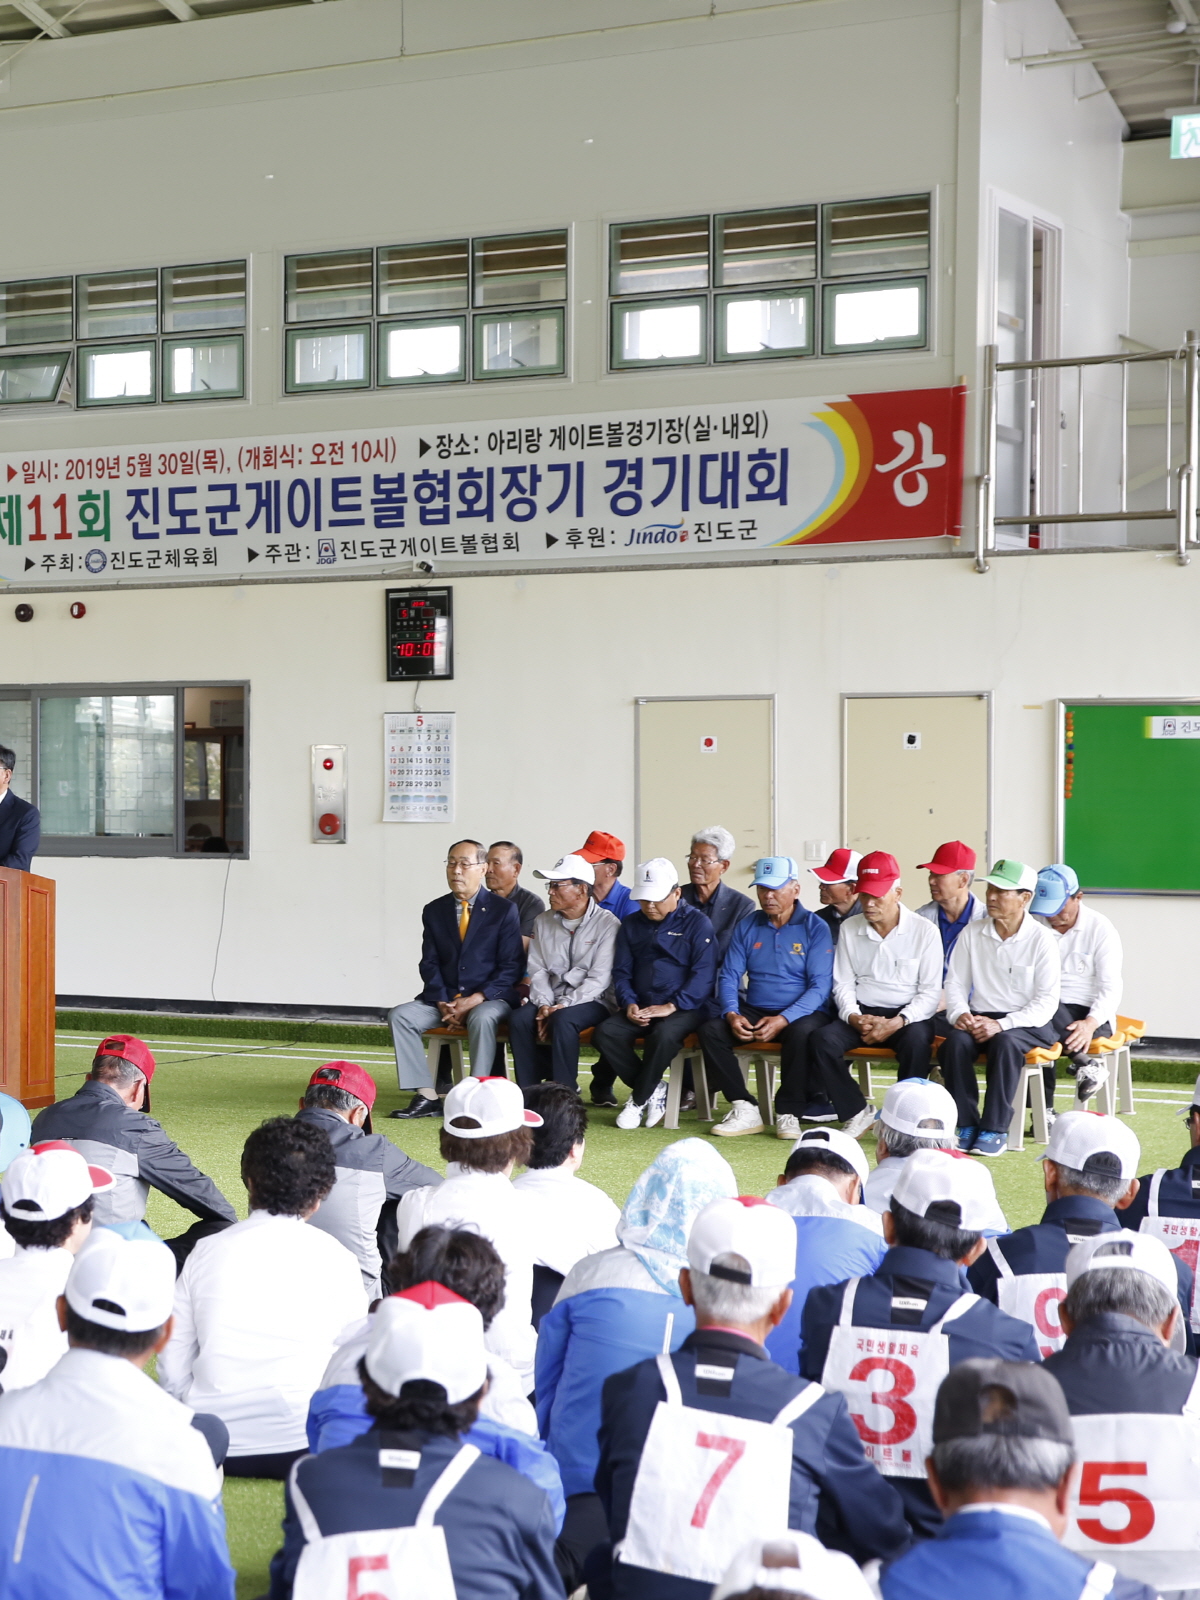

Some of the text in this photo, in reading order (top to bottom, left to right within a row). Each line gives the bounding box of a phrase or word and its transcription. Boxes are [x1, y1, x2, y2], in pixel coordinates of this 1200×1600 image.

[22, 460, 59, 484] 일시:
[65, 455, 121, 480] 2019년
[126, 453, 152, 477] 5월
[158, 448, 231, 476] 30일(목),
[238, 444, 303, 472] (개회식:
[310, 441, 344, 466] 오전
[351, 436, 397, 464] 10시)
[436, 432, 479, 460] 장소:
[488, 427, 543, 455] 아리랑
[875, 422, 946, 507] 강
[126, 461, 584, 540] 진도군게이트볼협회장기
[603, 447, 789, 518] 경기대회
[565, 526, 615, 549] 후원:
[625, 527, 678, 546] Jindo
[694, 518, 758, 543] 진도군
[265, 542, 310, 564] 주관:
[340, 531, 520, 559] 진도군게이트볼협회
[40, 553, 82, 574] 주최:
[110, 546, 218, 571] 진도군체육회
[400, 642, 442, 656] 10:0
[416, 715, 424, 727] 5
[1162, 1224, 1200, 1237] 국민생활
[856, 1338, 919, 1358] 국민생활체육
[848, 1356, 918, 1446] 3
[864, 1445, 912, 1463] 이트볼
[690, 1430, 747, 1529] 7
[1076, 1461, 1156, 1545] 5
